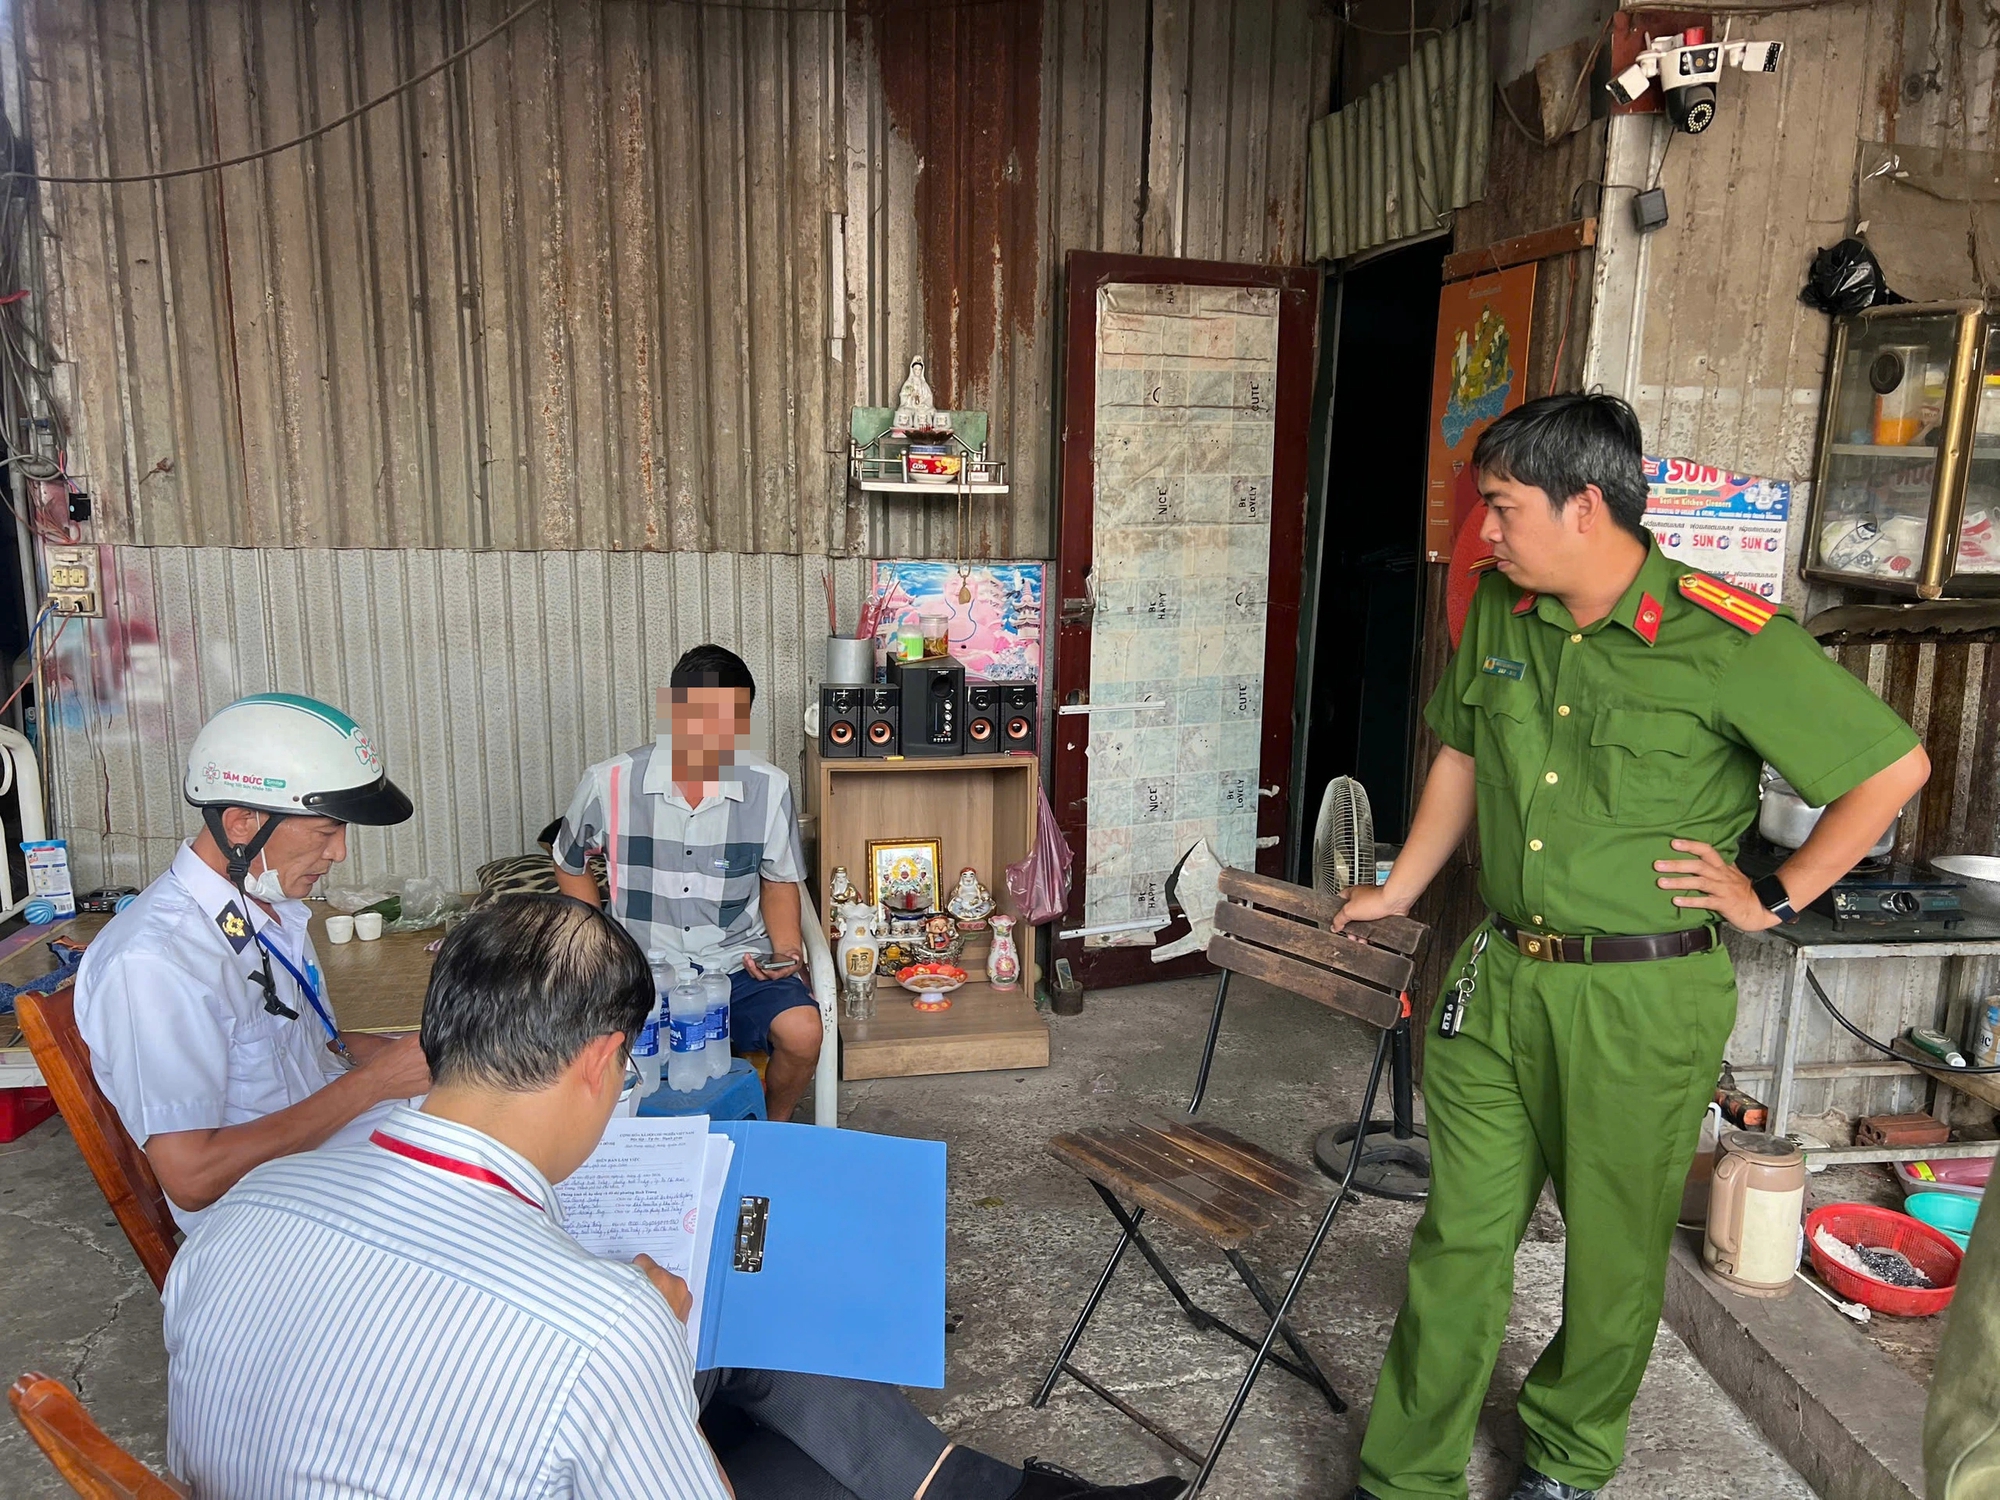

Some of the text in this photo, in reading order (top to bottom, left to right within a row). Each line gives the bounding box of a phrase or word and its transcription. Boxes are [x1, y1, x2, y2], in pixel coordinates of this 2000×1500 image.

[1251, 383, 1260, 412] CUTE
[1667, 458, 1718, 483] SUN
[1158, 488, 1168, 515] NICE
[1239, 497, 1247, 508] BE
[1249, 485, 1257, 518] LOVELY
[1692, 534, 1714, 547] SUN
[1740, 536, 1762, 549] SUN
[1738, 581, 1757, 593] UN
[1148, 600, 1157, 613] BE
[1157, 591, 1167, 620] HAPPY
[1239, 684, 1248, 711] CUTE
[222, 771, 240, 782] TÂM
[242, 774, 263, 785] ĐỨC
[1149, 785, 1159, 813] NICE
[1226, 788, 1235, 801] BE
[1236, 778, 1245, 809] LOVELY
[1138, 890, 1147, 904] BE
[1148, 881, 1157, 909] HAPPY
